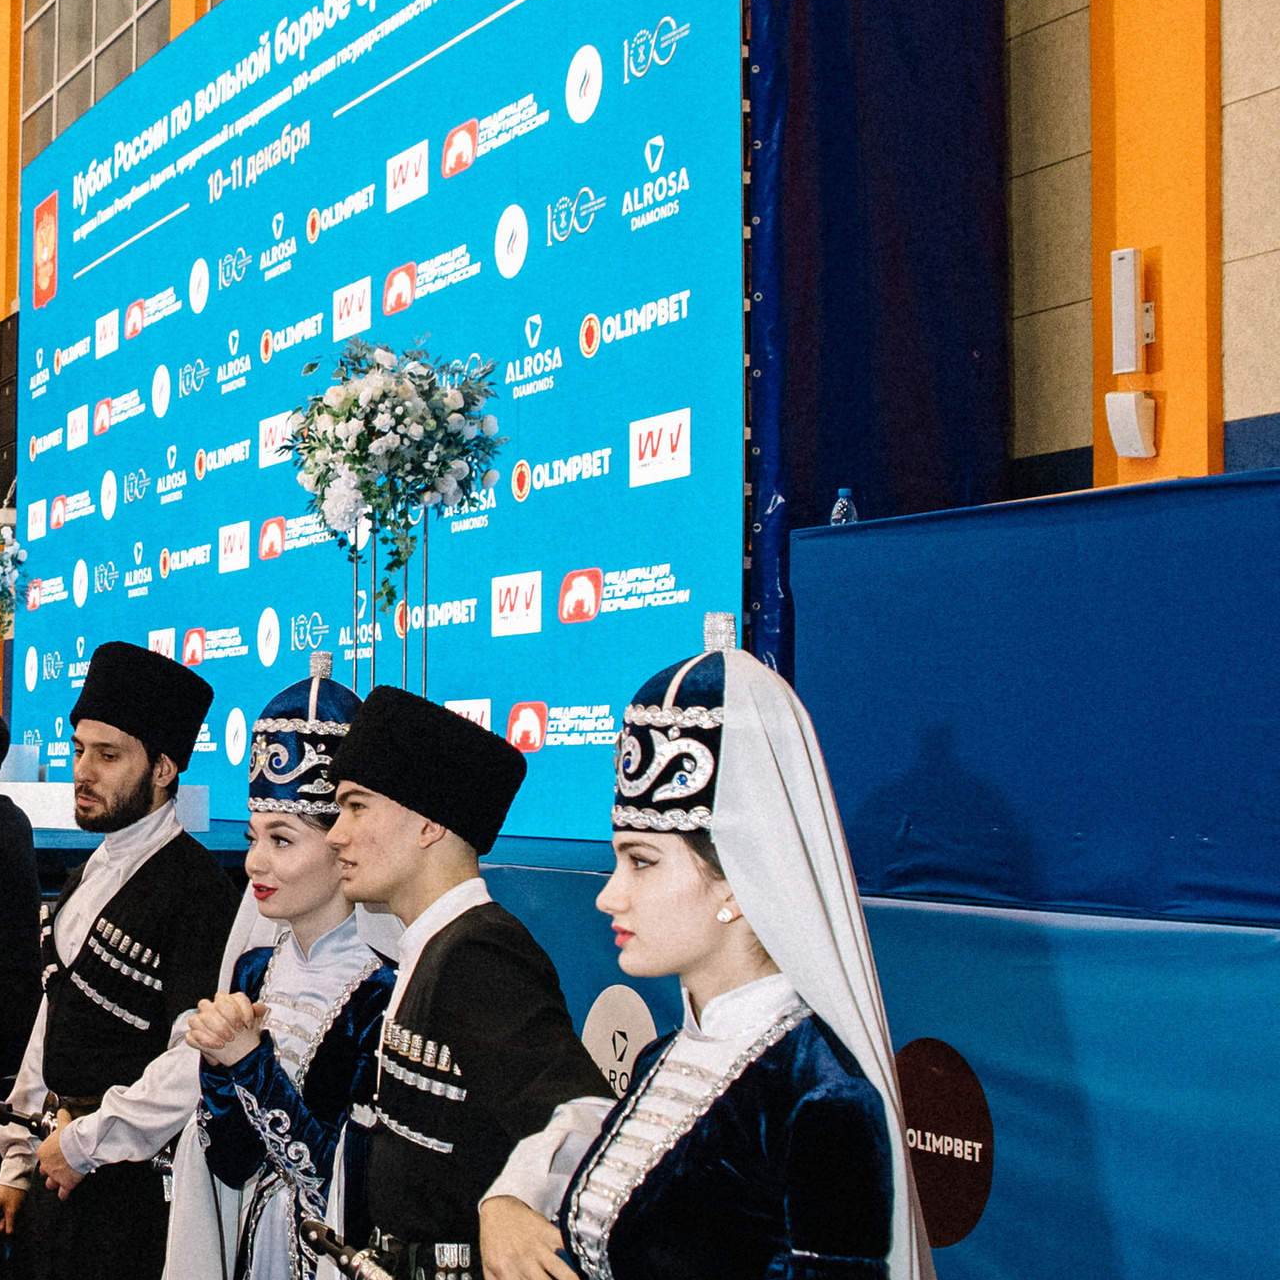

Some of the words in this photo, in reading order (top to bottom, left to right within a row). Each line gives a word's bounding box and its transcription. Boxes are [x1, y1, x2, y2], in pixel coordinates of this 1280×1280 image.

[73, 157, 112, 215] Кубок
[114, 116, 168, 178] России
[171, 100, 192, 138] по
[195, 31, 270, 121] вольной
[246, 120, 310, 187] декабря
[322, 184, 375, 231] OLIMPBET
[622, 168, 689, 216] ALROSA
[631, 200, 679, 231] DIAMONDS
[260, 237, 296, 270] ALROSA
[274, 313, 323, 352] OLIMPBET
[602, 290, 690, 343] OLIMPBET
[217, 355, 251, 383] ALROSA
[505, 347, 562, 384] ALROSA
[513, 376, 553, 399] DIAMONDS
[207, 439, 250, 471] OLIMPBET
[533, 448, 612, 489] OLIMPBET
[157, 470, 187, 493] ALROSA
[451, 514, 489, 533] DIAMONDS
[170, 544, 211, 571] OLIMPBET
[906, 1128, 983, 1163] OLIMPBET
